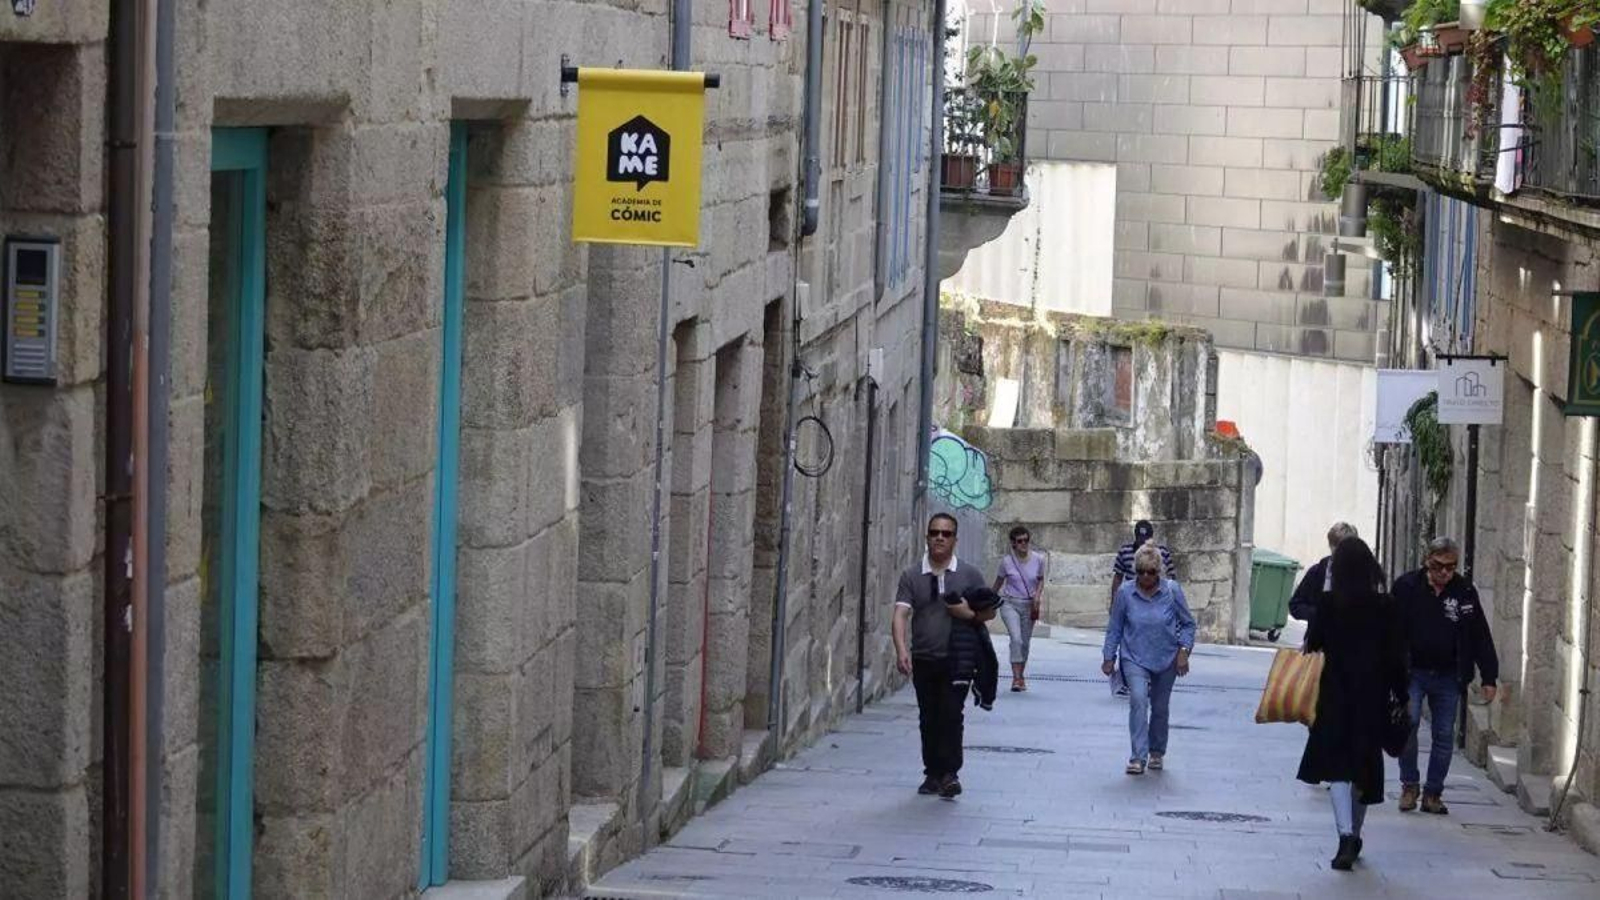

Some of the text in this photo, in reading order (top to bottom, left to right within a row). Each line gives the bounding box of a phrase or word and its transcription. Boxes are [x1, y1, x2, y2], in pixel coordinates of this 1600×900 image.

[621, 132, 657, 154] KA
[618, 155, 658, 175] ME
[611, 197, 651, 206] ACADEMIA
[611, 206, 661, 222] CÓMIC
